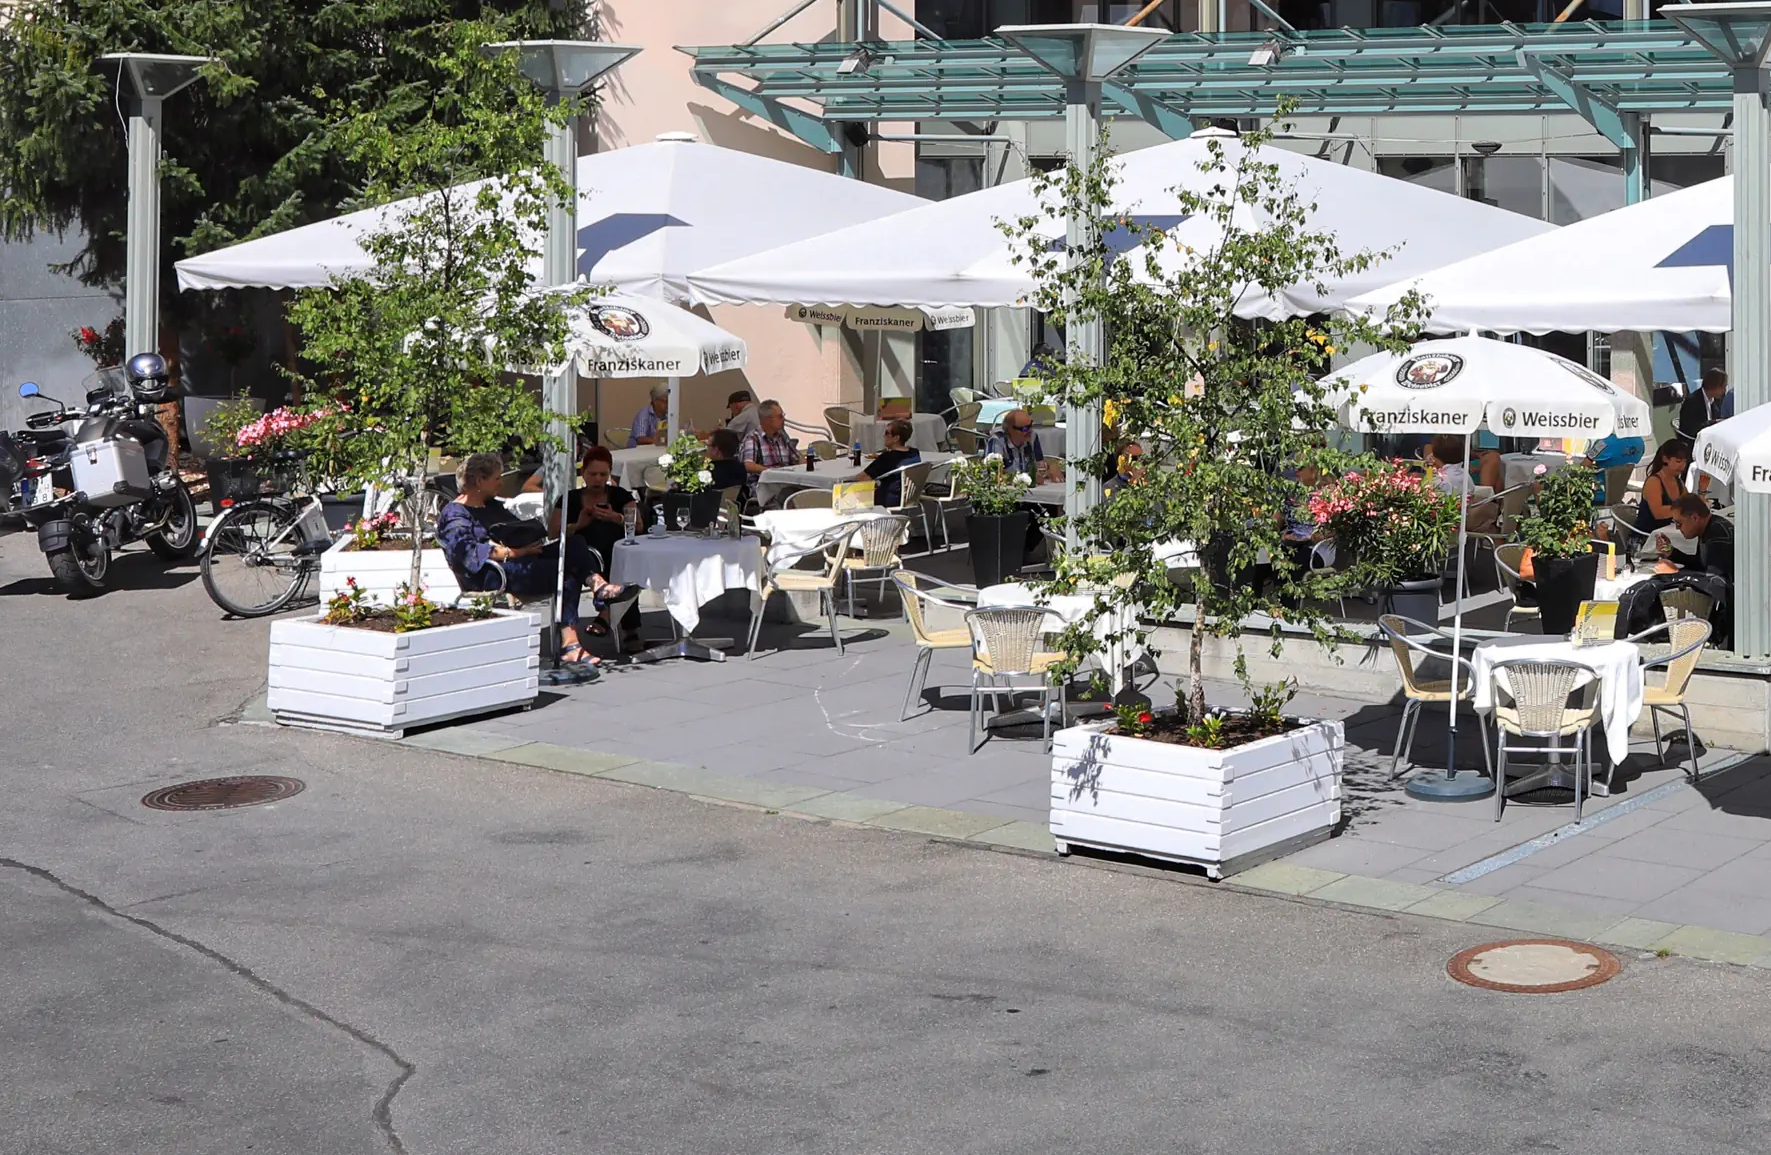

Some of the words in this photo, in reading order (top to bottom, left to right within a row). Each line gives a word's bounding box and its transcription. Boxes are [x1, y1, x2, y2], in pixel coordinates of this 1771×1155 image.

[809, 309, 842, 323] Weissbier
[855, 316, 915, 327] Franziskaner
[937, 313, 970, 325] Weissbier
[587, 356, 682, 371] Franziskaner
[1522, 411, 1600, 429] Weissbier
